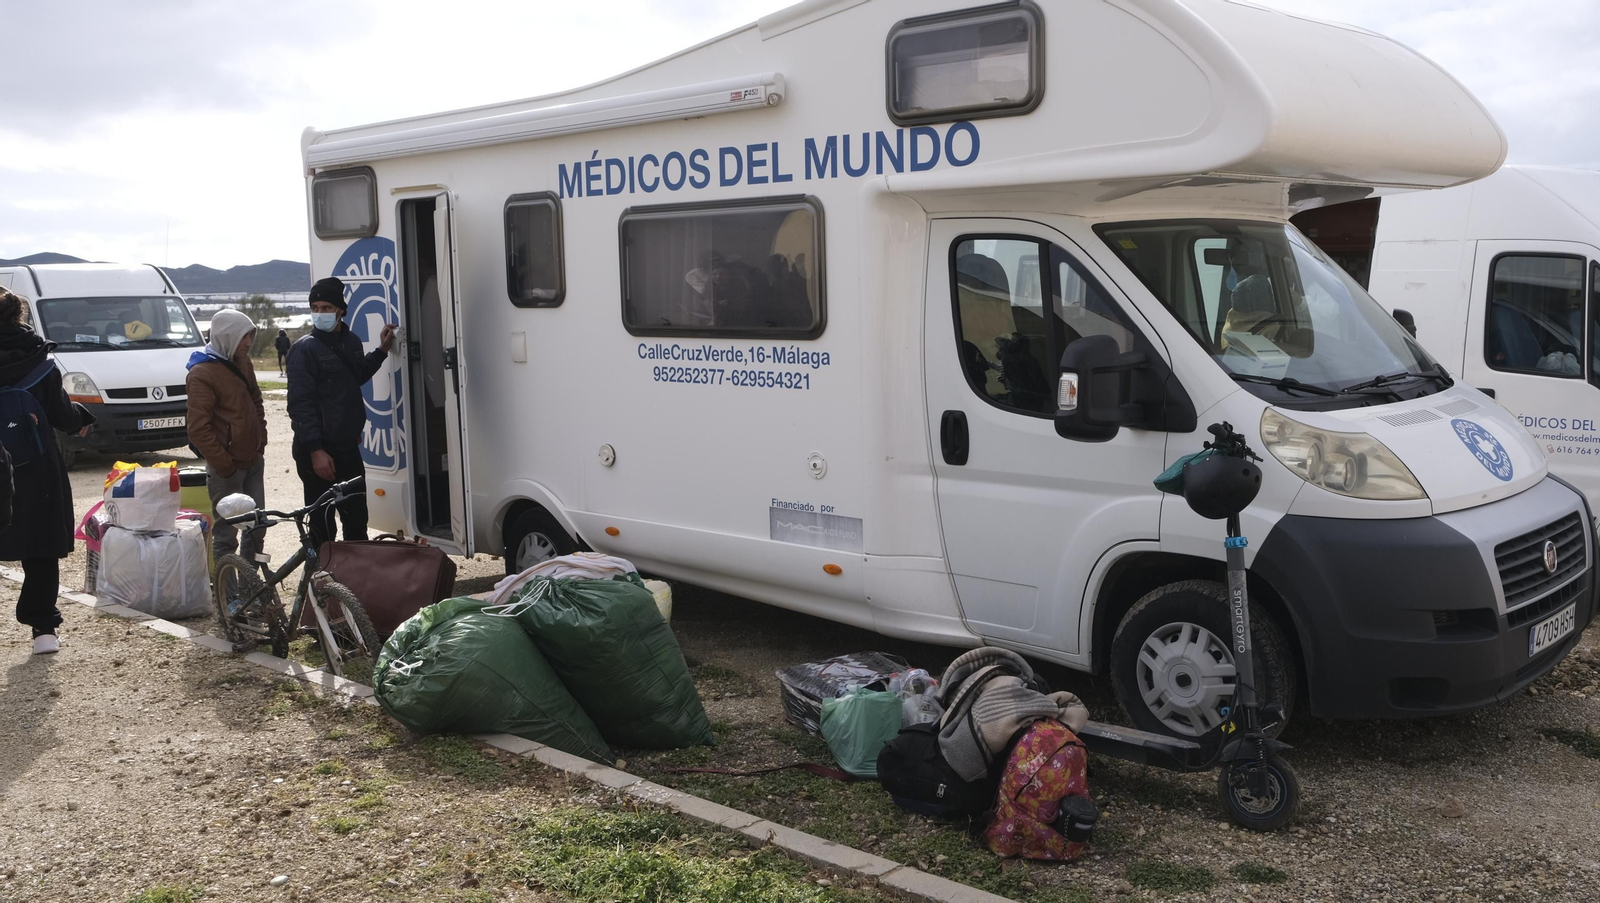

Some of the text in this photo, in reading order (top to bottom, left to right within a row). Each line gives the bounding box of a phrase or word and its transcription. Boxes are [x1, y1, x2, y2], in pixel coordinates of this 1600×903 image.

[558, 121, 981, 200] MÉDICOS DEL MUNDO
[653, 366, 810, 390] 952252377-629554321
[143, 417, 184, 429] 2507 FFK
[1571, 418, 1597, 432] DEL
[1556, 445, 1573, 454] 616
[1575, 446, 1592, 455] 764
[1475, 450, 1511, 478] DEL MUNDO
[771, 498, 835, 513] Financiado por
[823, 527, 838, 537] AIDS
[839, 529, 857, 540] FUND
[1233, 590, 1246, 653] smartGyro
[1535, 606, 1575, 648] 4709 HSH
